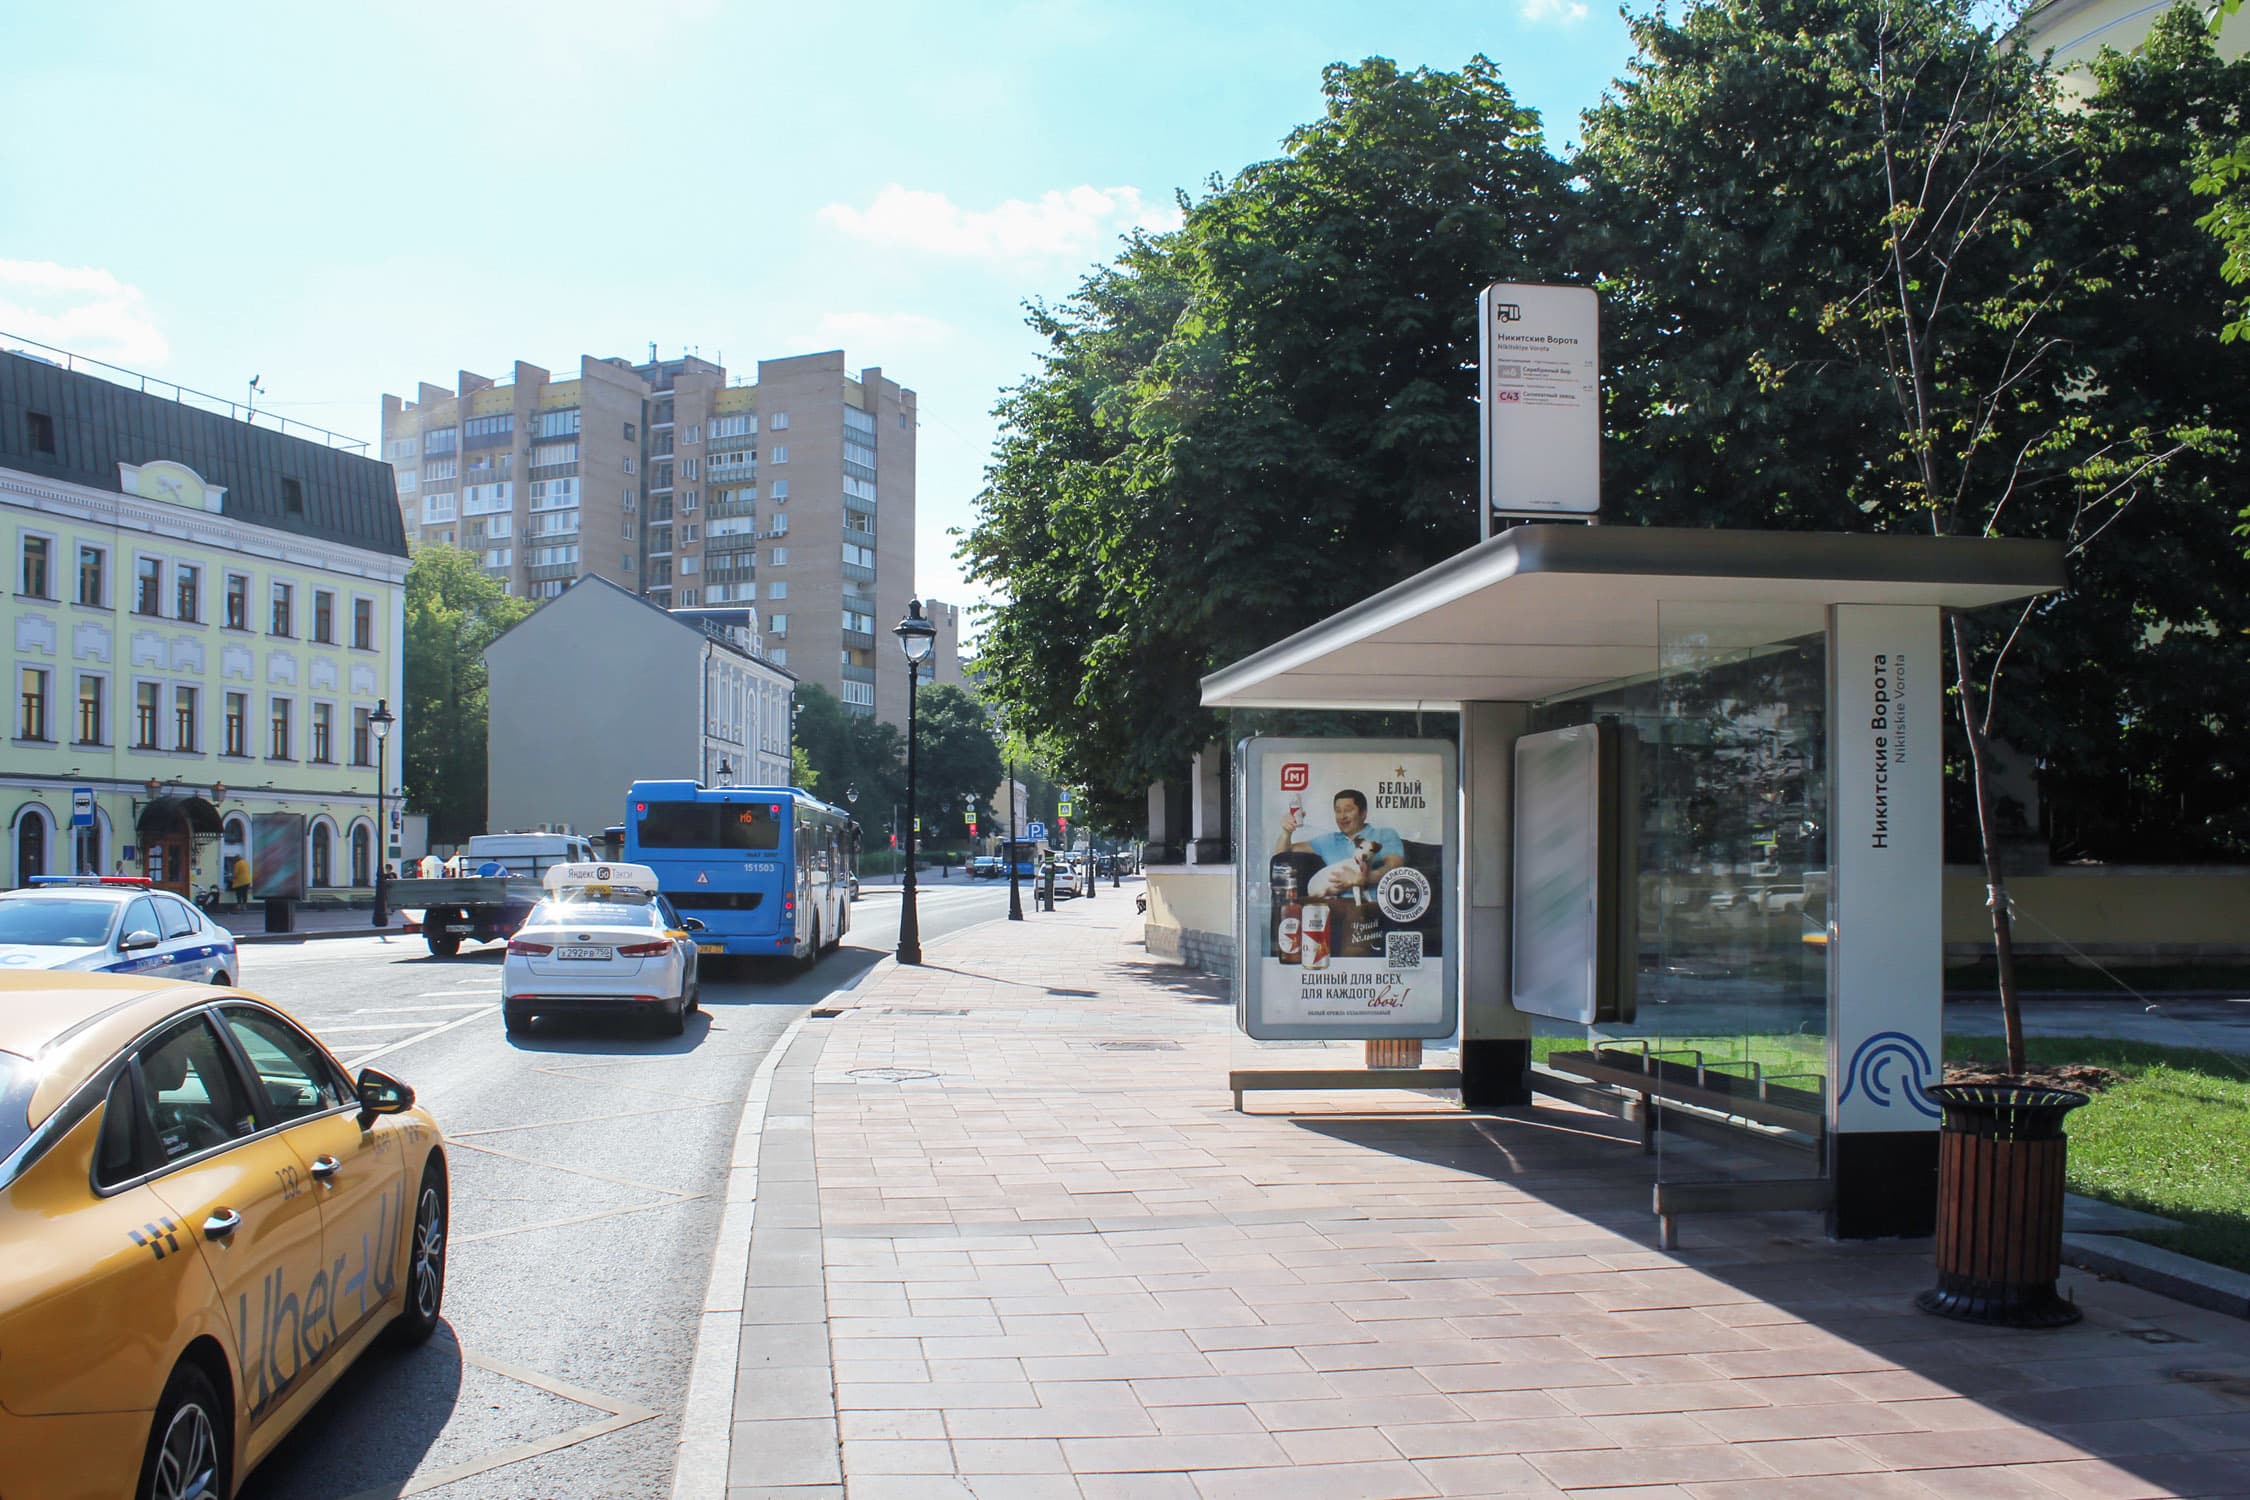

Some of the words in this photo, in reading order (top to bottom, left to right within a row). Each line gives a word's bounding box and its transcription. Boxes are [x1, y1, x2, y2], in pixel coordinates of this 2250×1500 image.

[1497, 333, 1545, 343] Никитские
[1547, 335, 1578, 345] Ворота
[1894, 654, 1906, 700] Vorota
[1871, 654, 1890, 730] Ворота
[1894, 703, 1906, 763] Nikitskie
[1378, 780, 1422, 795] БЕЛЫЙ
[1872, 736, 1888, 849] Никитские
[1376, 796, 1426, 809] КРЕМЛЬ
[568, 868, 596, 880] Яндекс
[612, 868, 633, 879] Такси
[744, 863, 775, 872] 151503
[1383, 905, 1424, 920] ПРОДУКЦИЯ
[561, 948, 594, 957] 292РВ
[1301, 971, 1347, 985] ЕДИНЫЙ
[1349, 973, 1372, 985] ДЛЯ
[1301, 988, 1322, 999] ДЛЯ
[1326, 988, 1376, 999] КАЖДОГО
